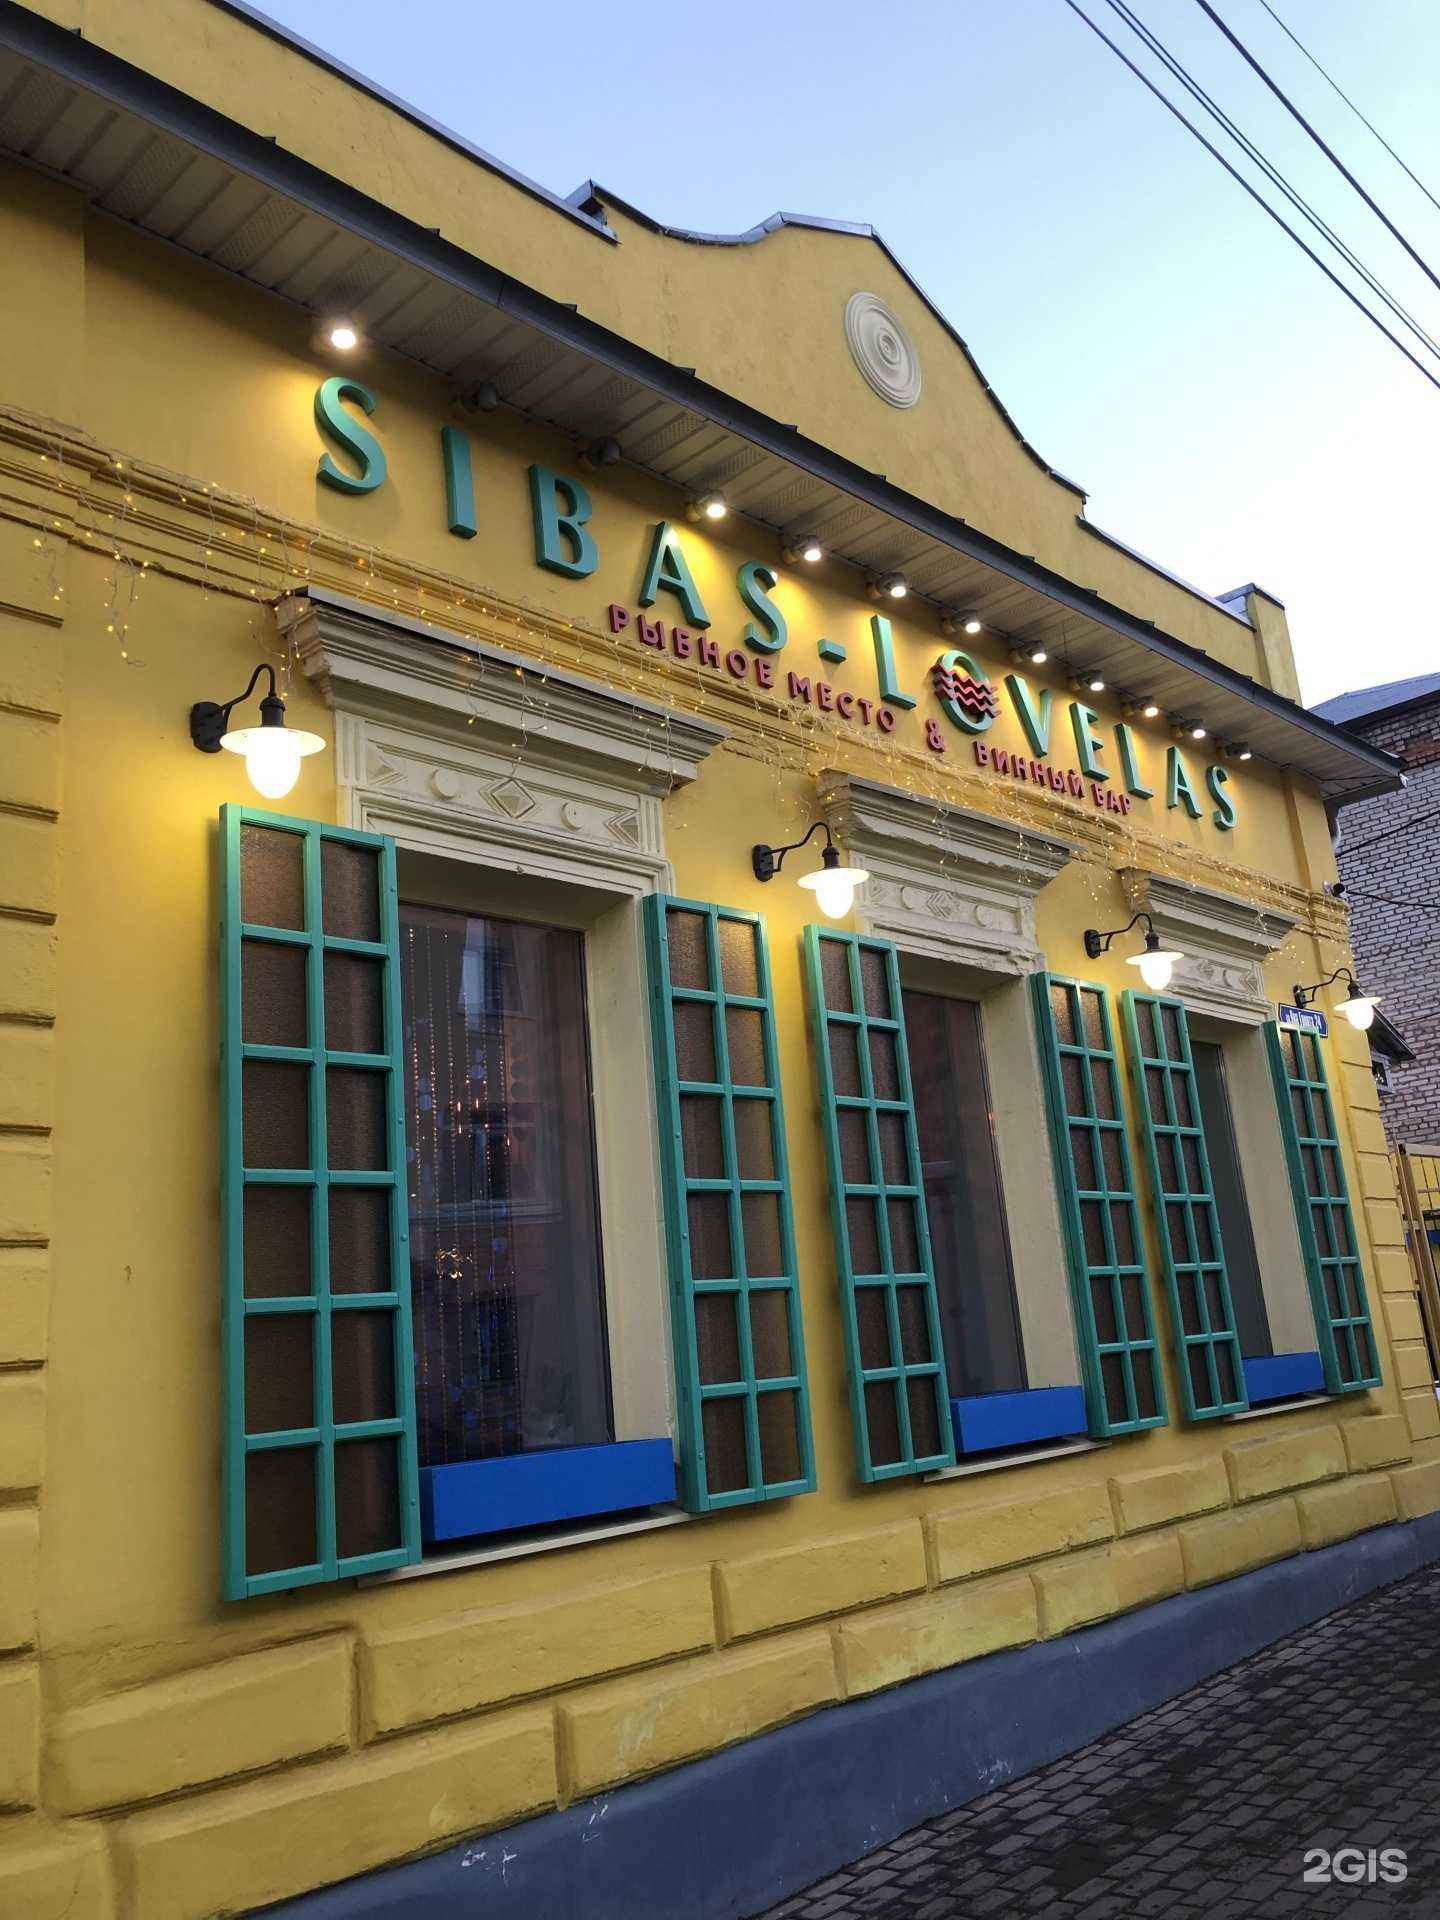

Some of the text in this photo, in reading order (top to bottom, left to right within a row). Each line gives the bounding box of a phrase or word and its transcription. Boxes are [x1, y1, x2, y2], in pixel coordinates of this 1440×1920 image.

[609, 603, 1133, 815] РЫБНОЕ МЕСТО & ВИННЫЙ БАР
